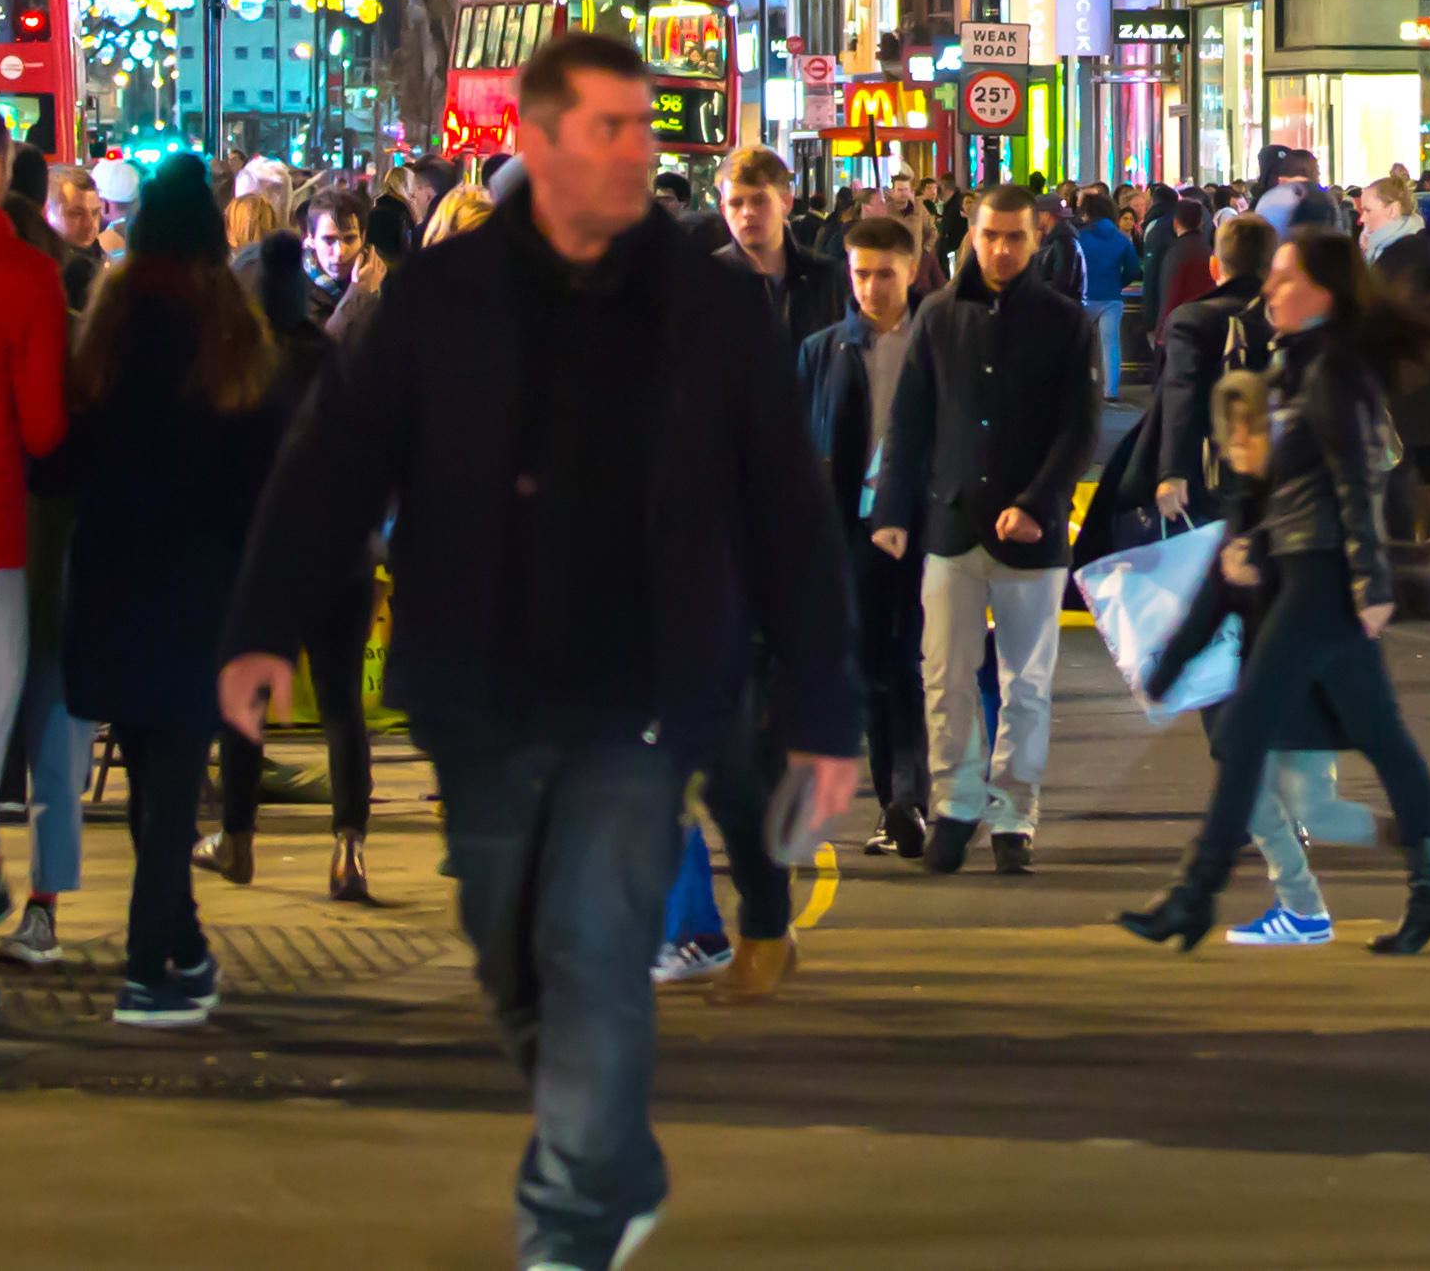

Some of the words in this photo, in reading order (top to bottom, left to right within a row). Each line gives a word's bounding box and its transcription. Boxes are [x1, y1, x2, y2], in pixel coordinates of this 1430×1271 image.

[974, 30, 1017, 42] WEAK
[1119, 24, 1185, 39] ZARA
[974, 45, 1017, 56] ROAD
[975, 86, 1010, 103] 25T
